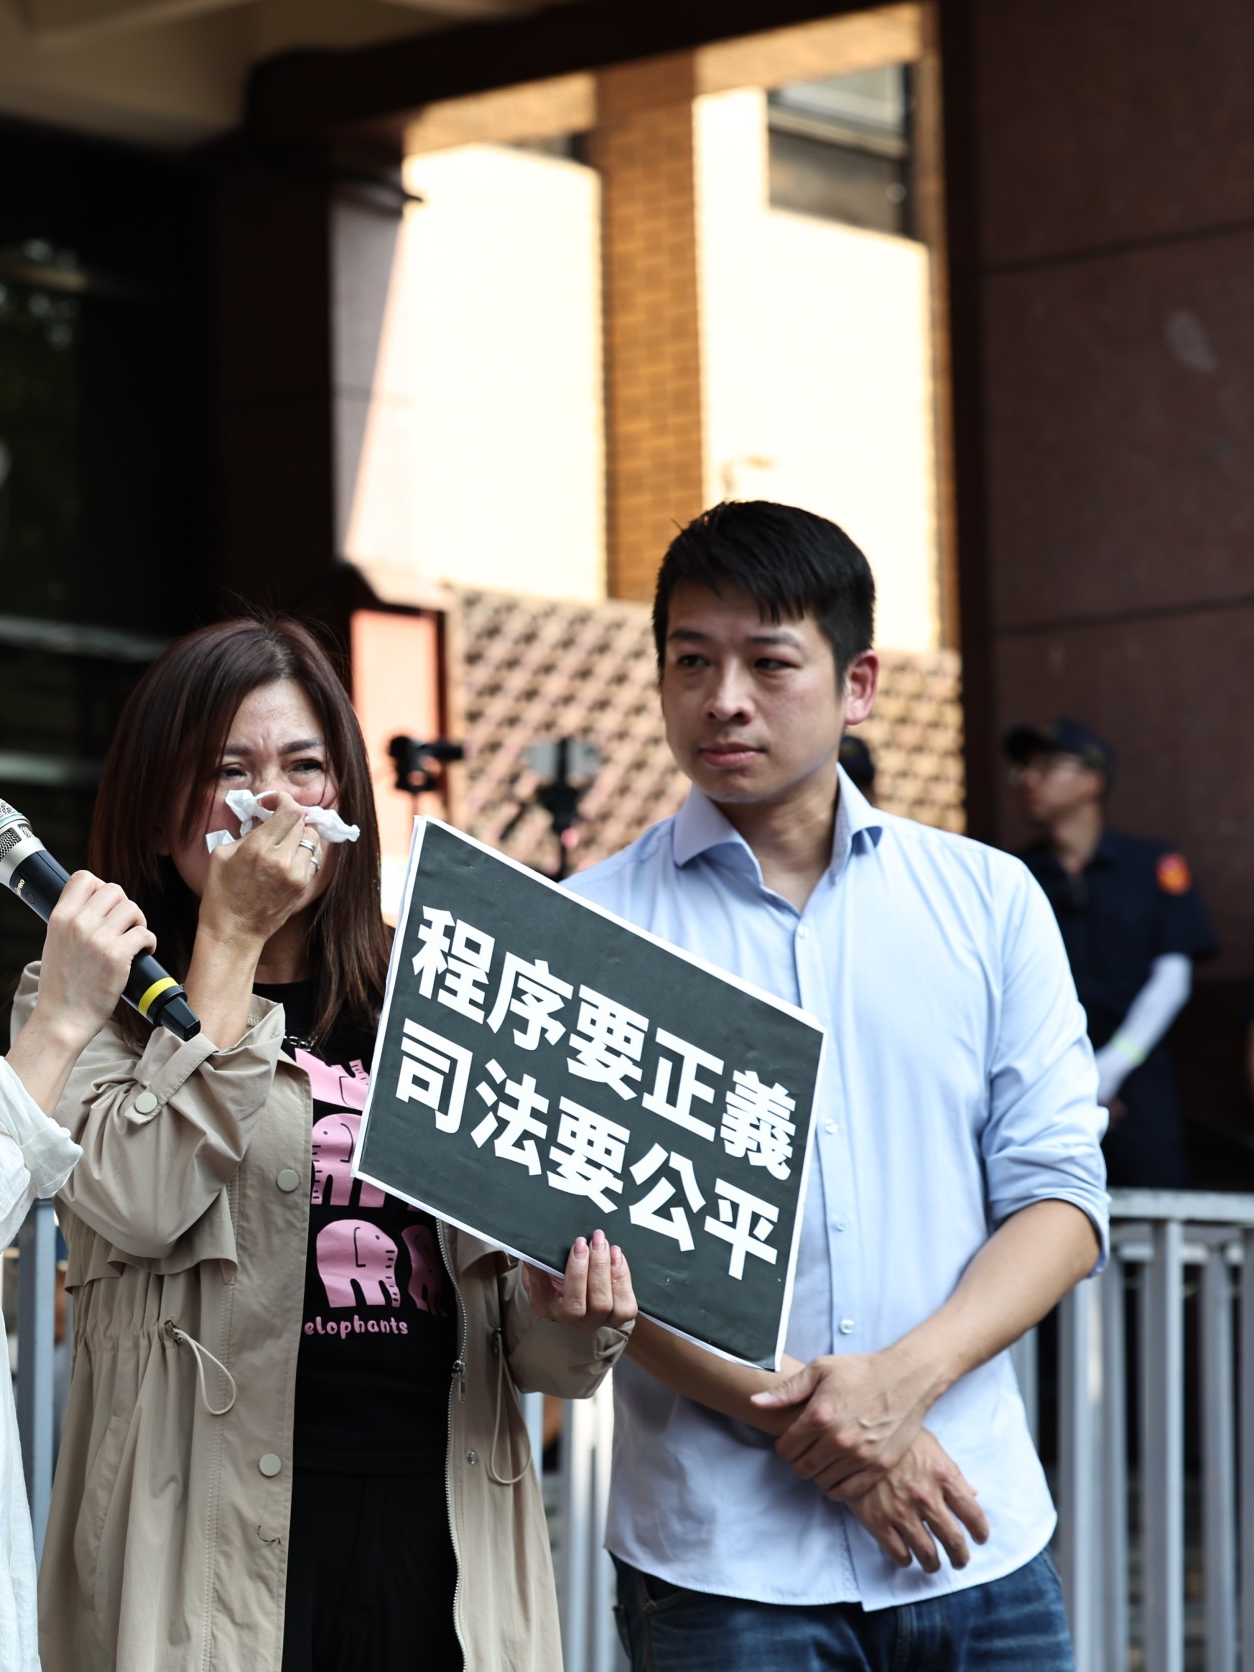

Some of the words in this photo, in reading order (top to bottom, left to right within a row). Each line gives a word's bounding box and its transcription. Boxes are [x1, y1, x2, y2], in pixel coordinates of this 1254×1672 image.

[396, 1018, 780, 1280] 司法要公平
[412, 906, 796, 1180] 程序要正義
